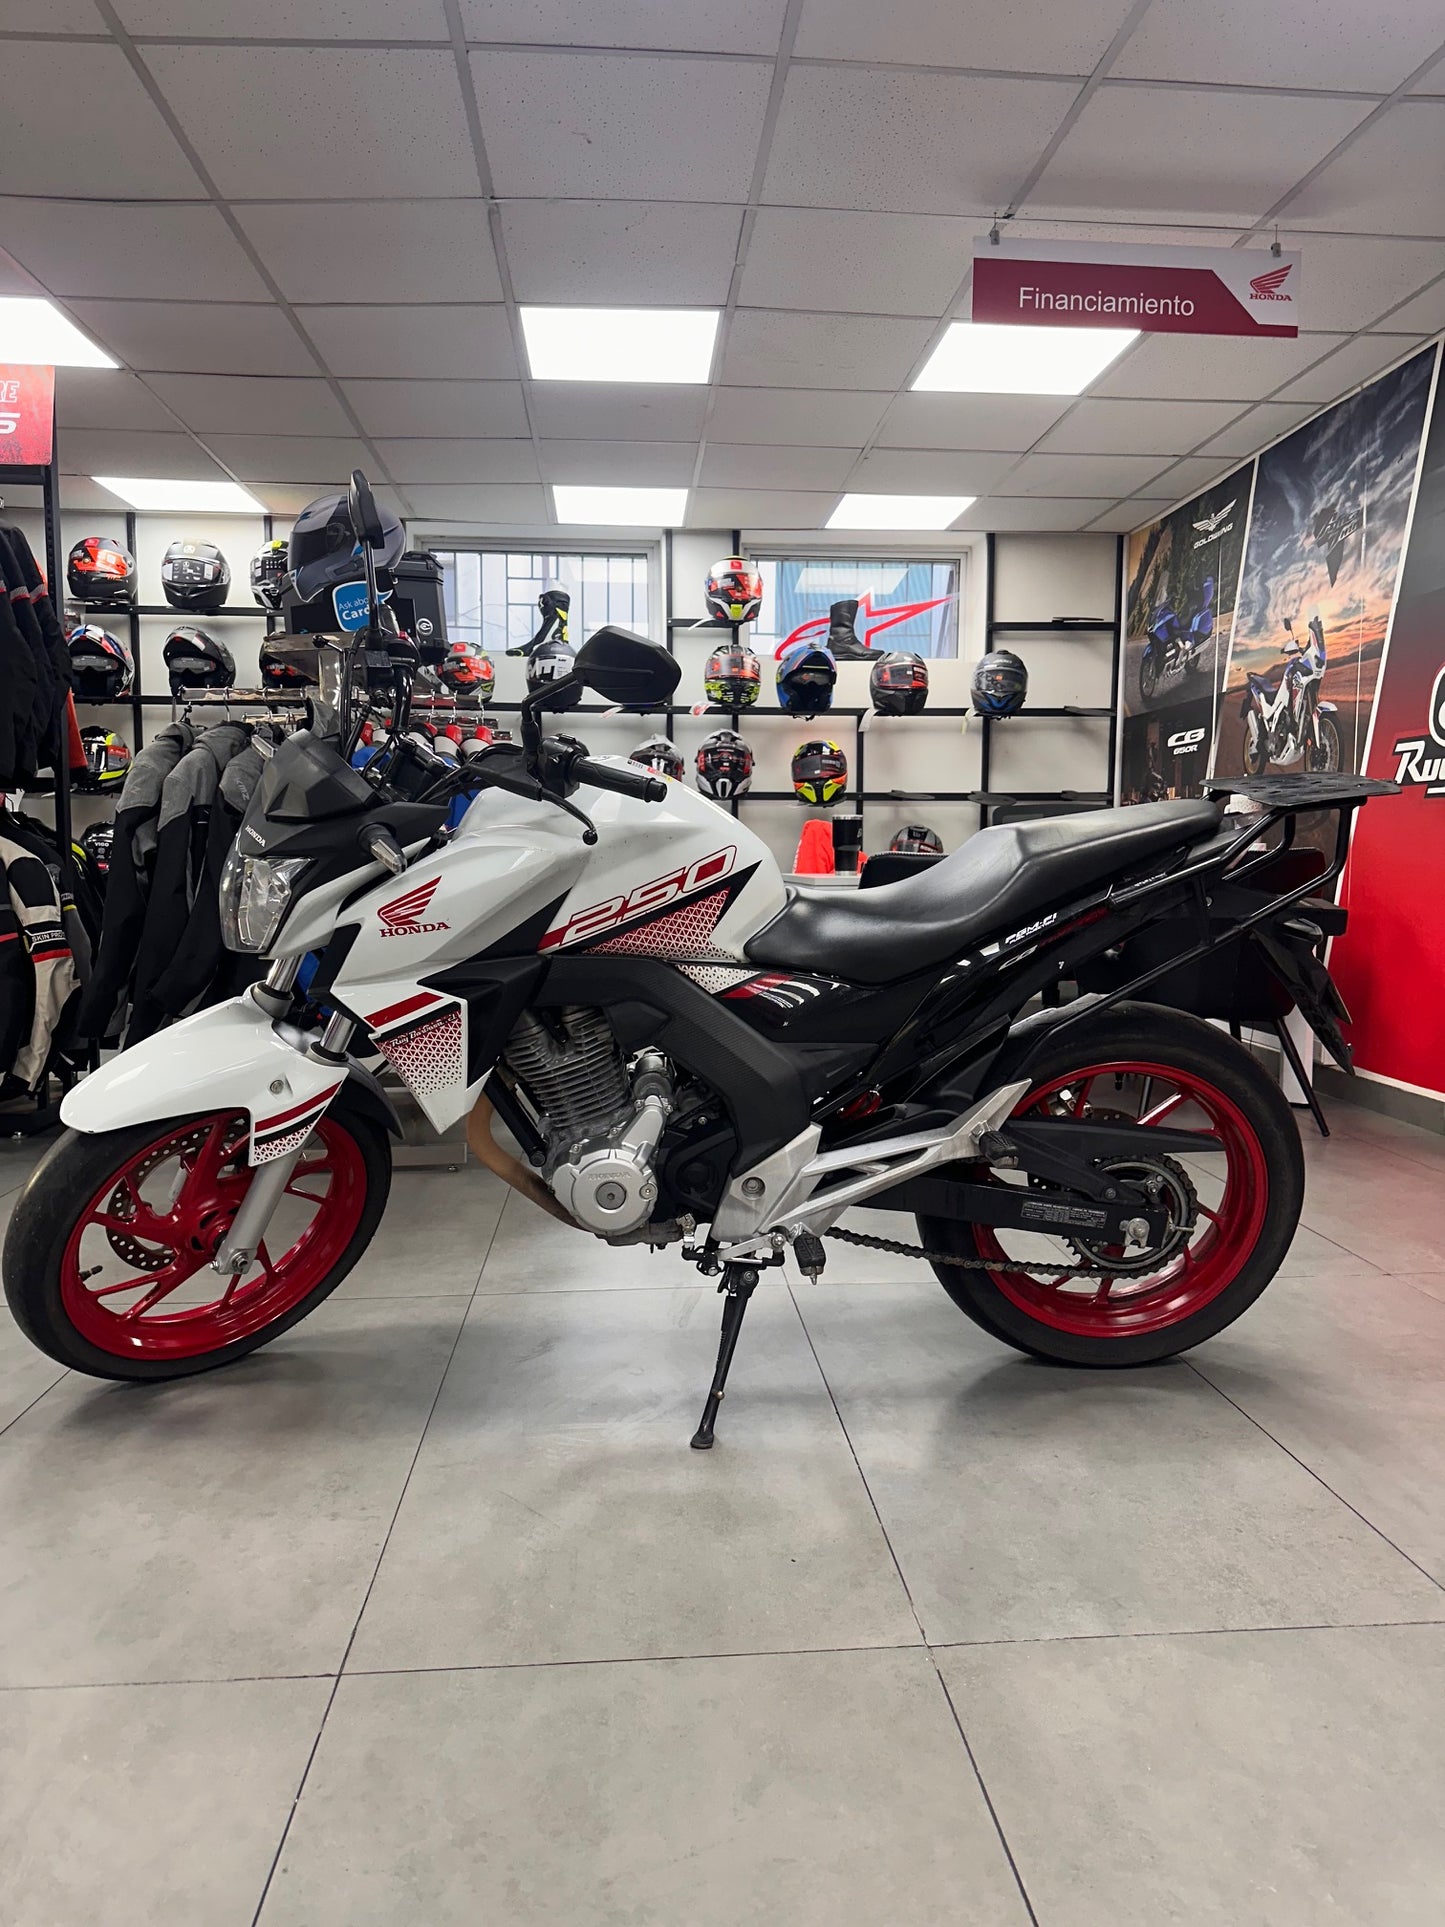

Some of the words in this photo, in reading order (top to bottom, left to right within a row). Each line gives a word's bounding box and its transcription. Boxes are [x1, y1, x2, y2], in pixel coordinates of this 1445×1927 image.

[1019, 286, 1194, 316] Financiamiento
[1250, 293, 1292, 302] HONDA
[1193, 522, 1234, 549] GOLDWING
[339, 601, 353, 610] Ask
[1167, 728, 1205, 747] CB
[1394, 740, 1445, 784] Ru
[245, 824, 266, 848] HONDA
[559, 845, 738, 947] 250
[32, 934, 49, 943] SKIN
[379, 921, 452, 938] HONDA
